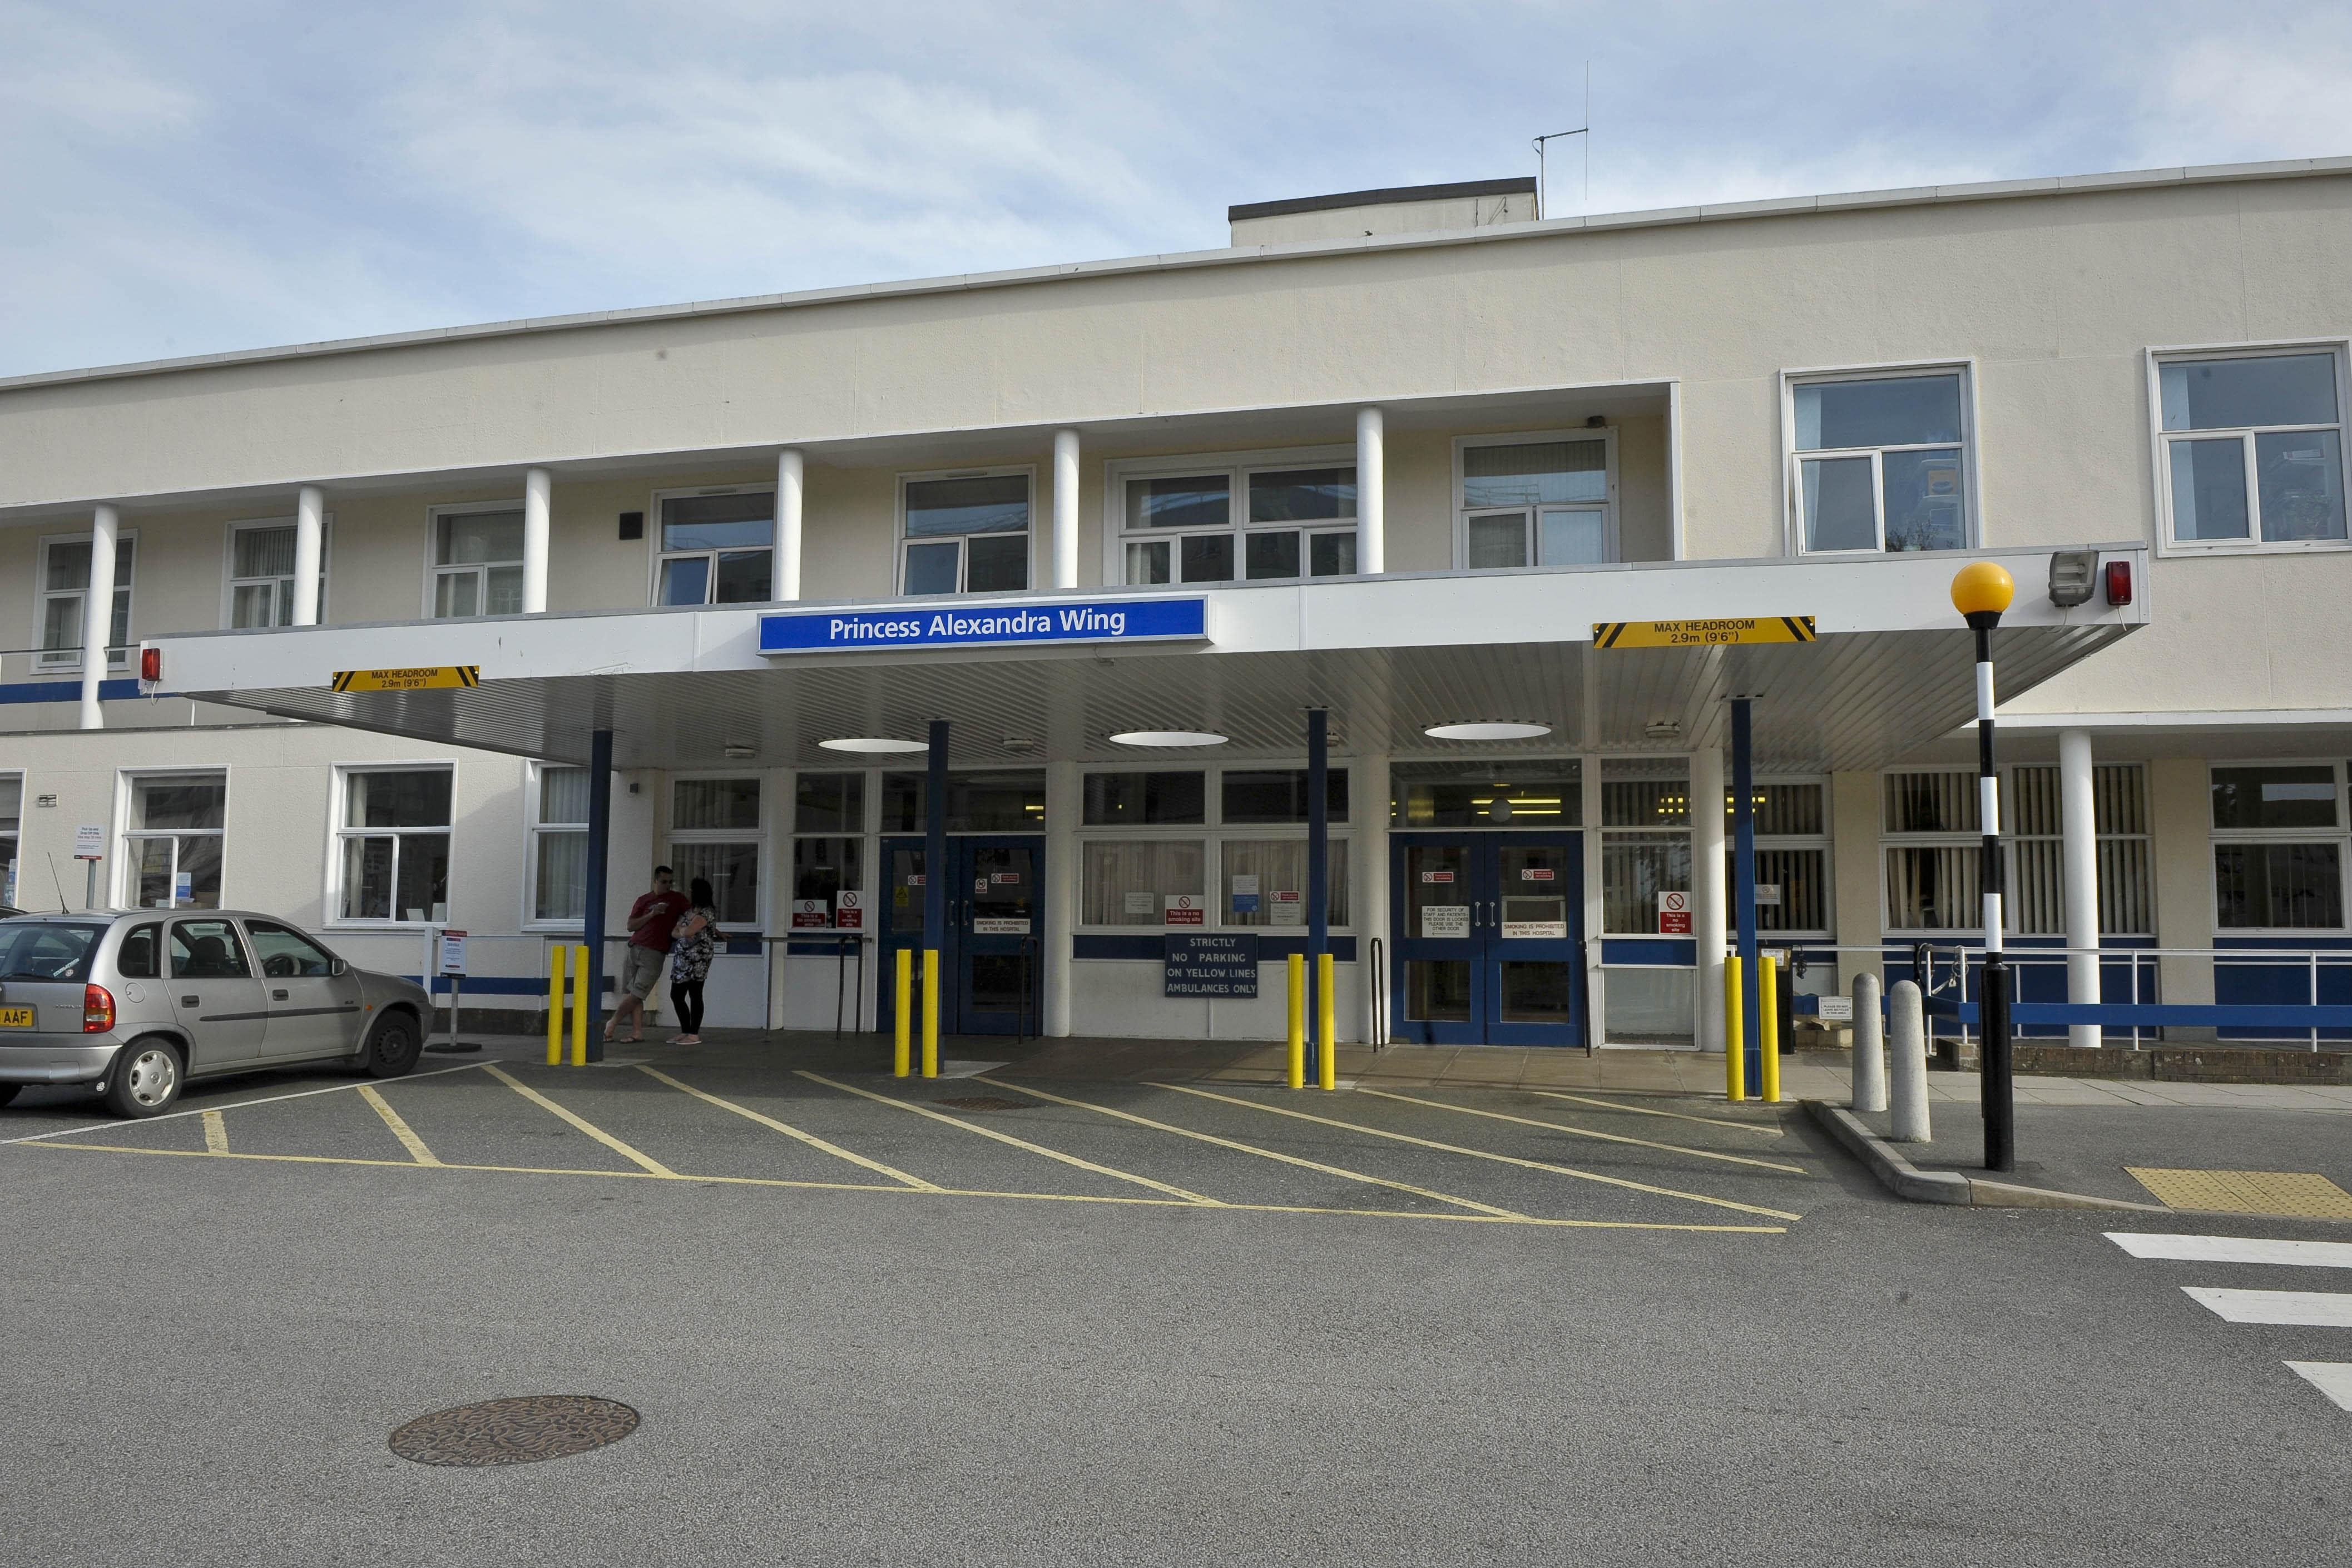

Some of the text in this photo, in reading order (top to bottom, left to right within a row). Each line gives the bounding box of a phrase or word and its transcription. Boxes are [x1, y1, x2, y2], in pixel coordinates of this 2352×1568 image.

[830, 608, 1125, 639] Princess Alexandra Wing
[1654, 620, 1755, 632] MAX HEADROOM
[1671, 633, 1700, 643] 2.9m
[392, 669, 438, 678] HEADROOM
[1190, 938, 1236, 947] STRICTLY
[1172, 953, 1246, 962] NO PARKING
[1167, 968, 1255, 977] ON YELLOW LINES
[1167, 984, 1256, 993] AMBULANCES ONLY
[4, 1011, 28, 1024] AAF
